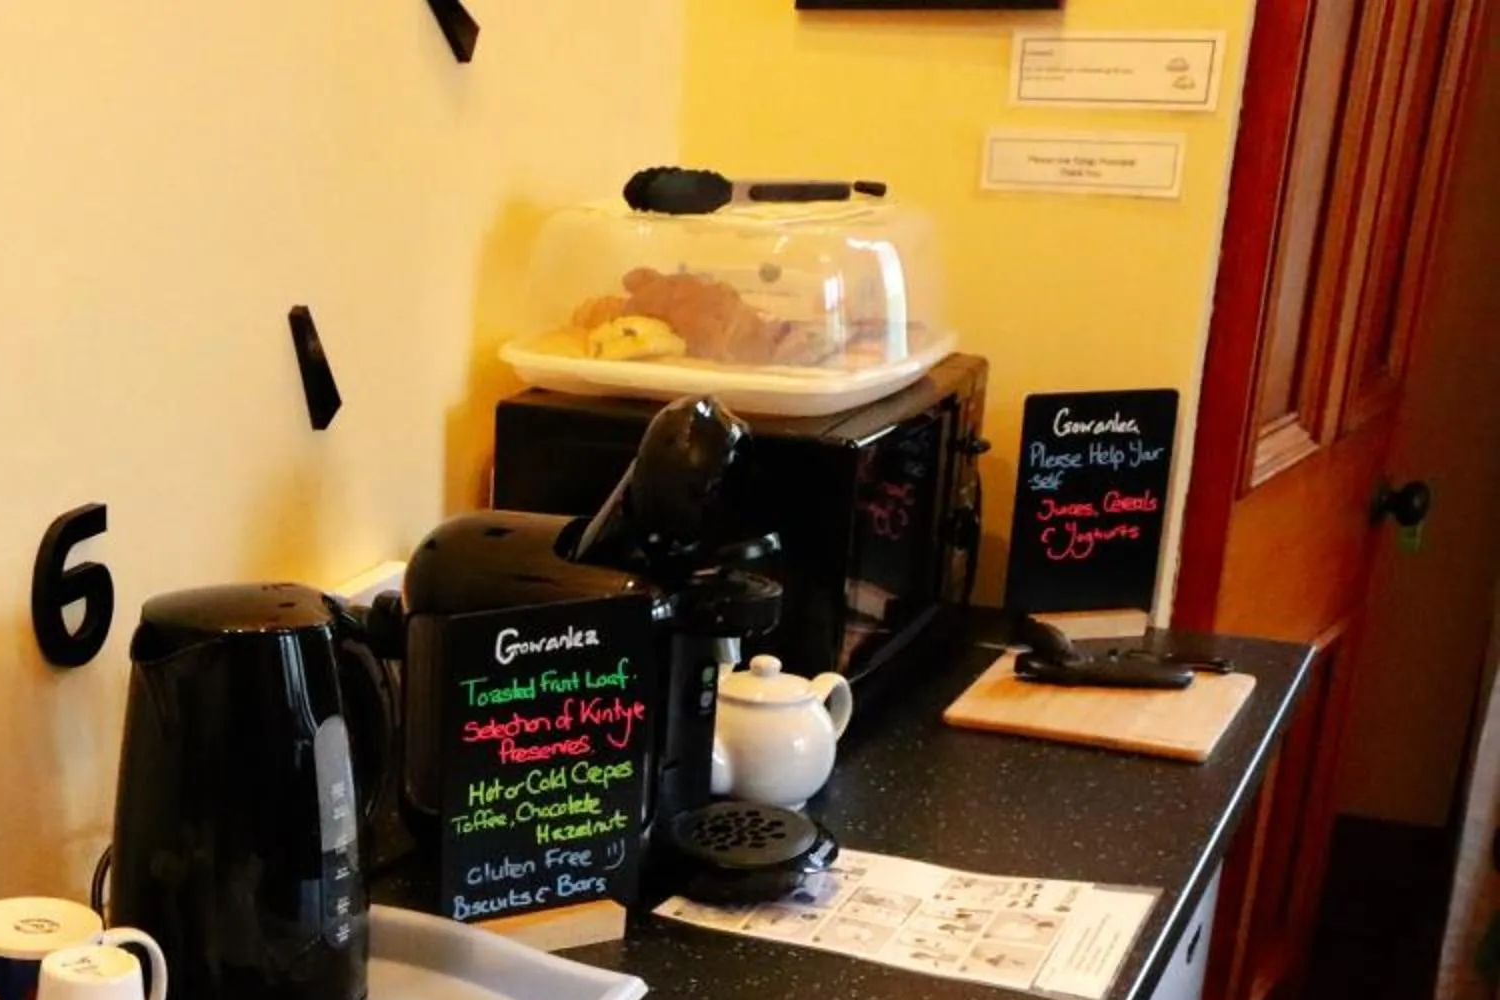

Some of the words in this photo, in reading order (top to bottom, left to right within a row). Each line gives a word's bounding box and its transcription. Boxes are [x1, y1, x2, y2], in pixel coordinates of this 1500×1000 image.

[1030, 441, 1084, 468] Please
[1089, 443, 1125, 471] Help
[31, 503, 115, 667] 6
[459, 677, 536, 706] Toasted
[463, 712, 550, 742] Selection
[555, 698, 575, 730] of
[469, 777, 504, 807] Hot
[504, 780, 526, 799] or
[526, 766, 567, 794] Cold
[536, 810, 628, 845] Hazelnut
[466, 855, 536, 886] Gluten
[544, 848, 593, 868] Free
[452, 888, 533, 921] Biscuits
[557, 874, 607, 897] Bars
